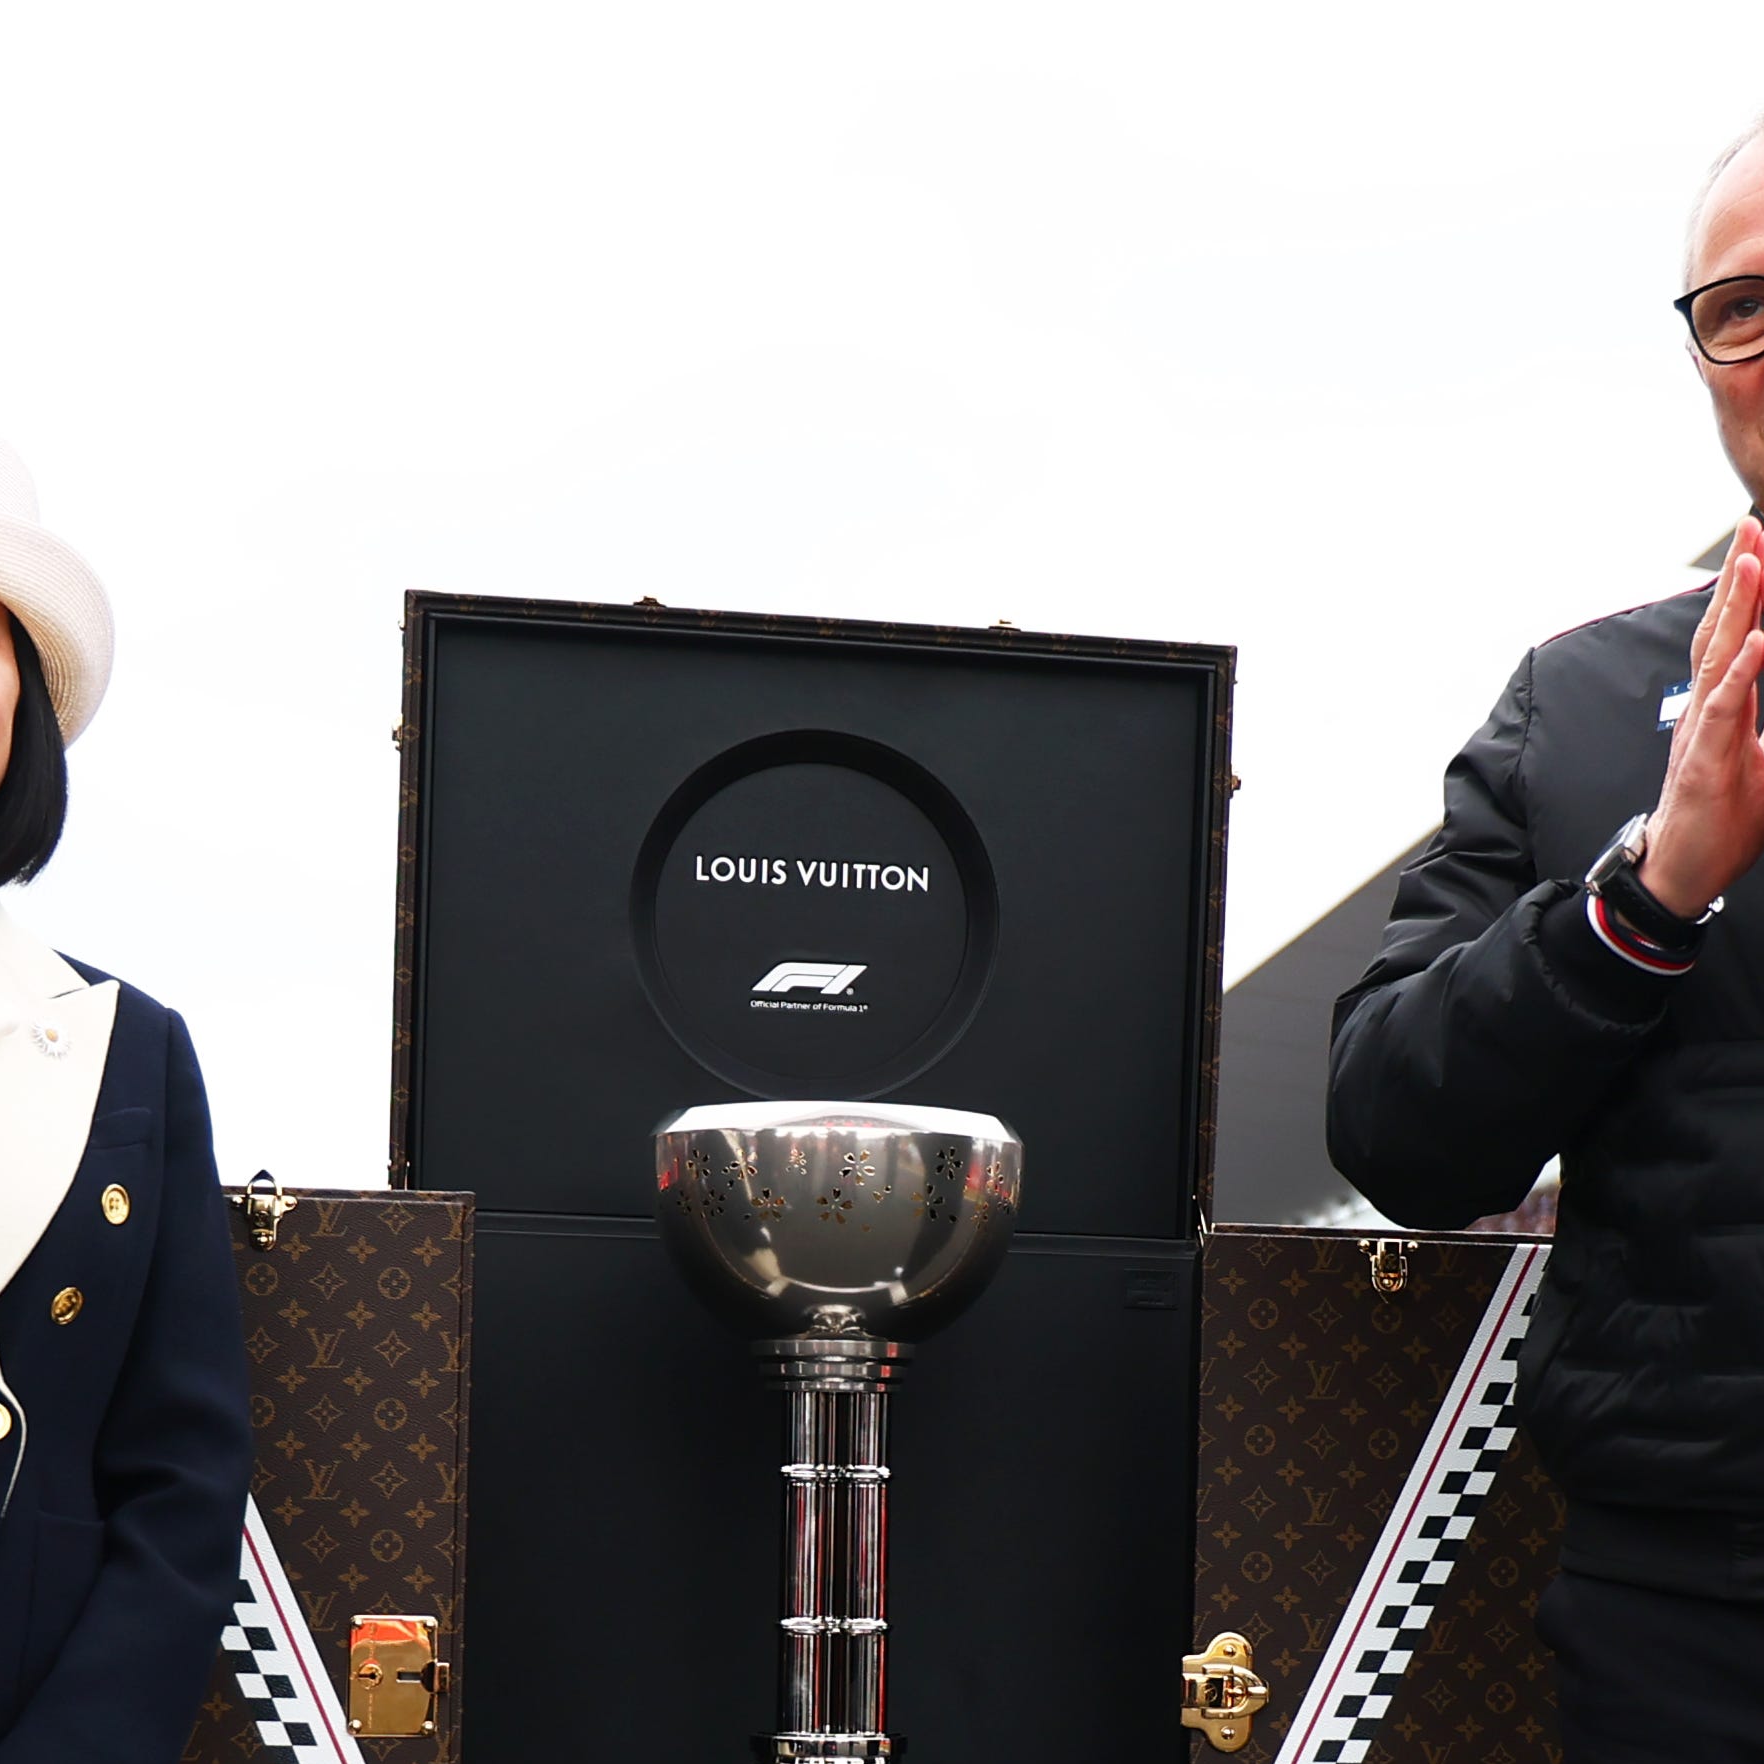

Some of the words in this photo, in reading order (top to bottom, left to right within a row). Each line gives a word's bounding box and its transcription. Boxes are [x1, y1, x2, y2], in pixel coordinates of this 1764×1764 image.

[696, 855, 787, 885] LOUIS
[796, 860, 929, 892] VUITTON
[750, 1000, 780, 1009] Official
[781, 1001, 811, 1010] Partner
[812, 1002, 821, 1010] of
[823, 1003, 857, 1012] Formula
